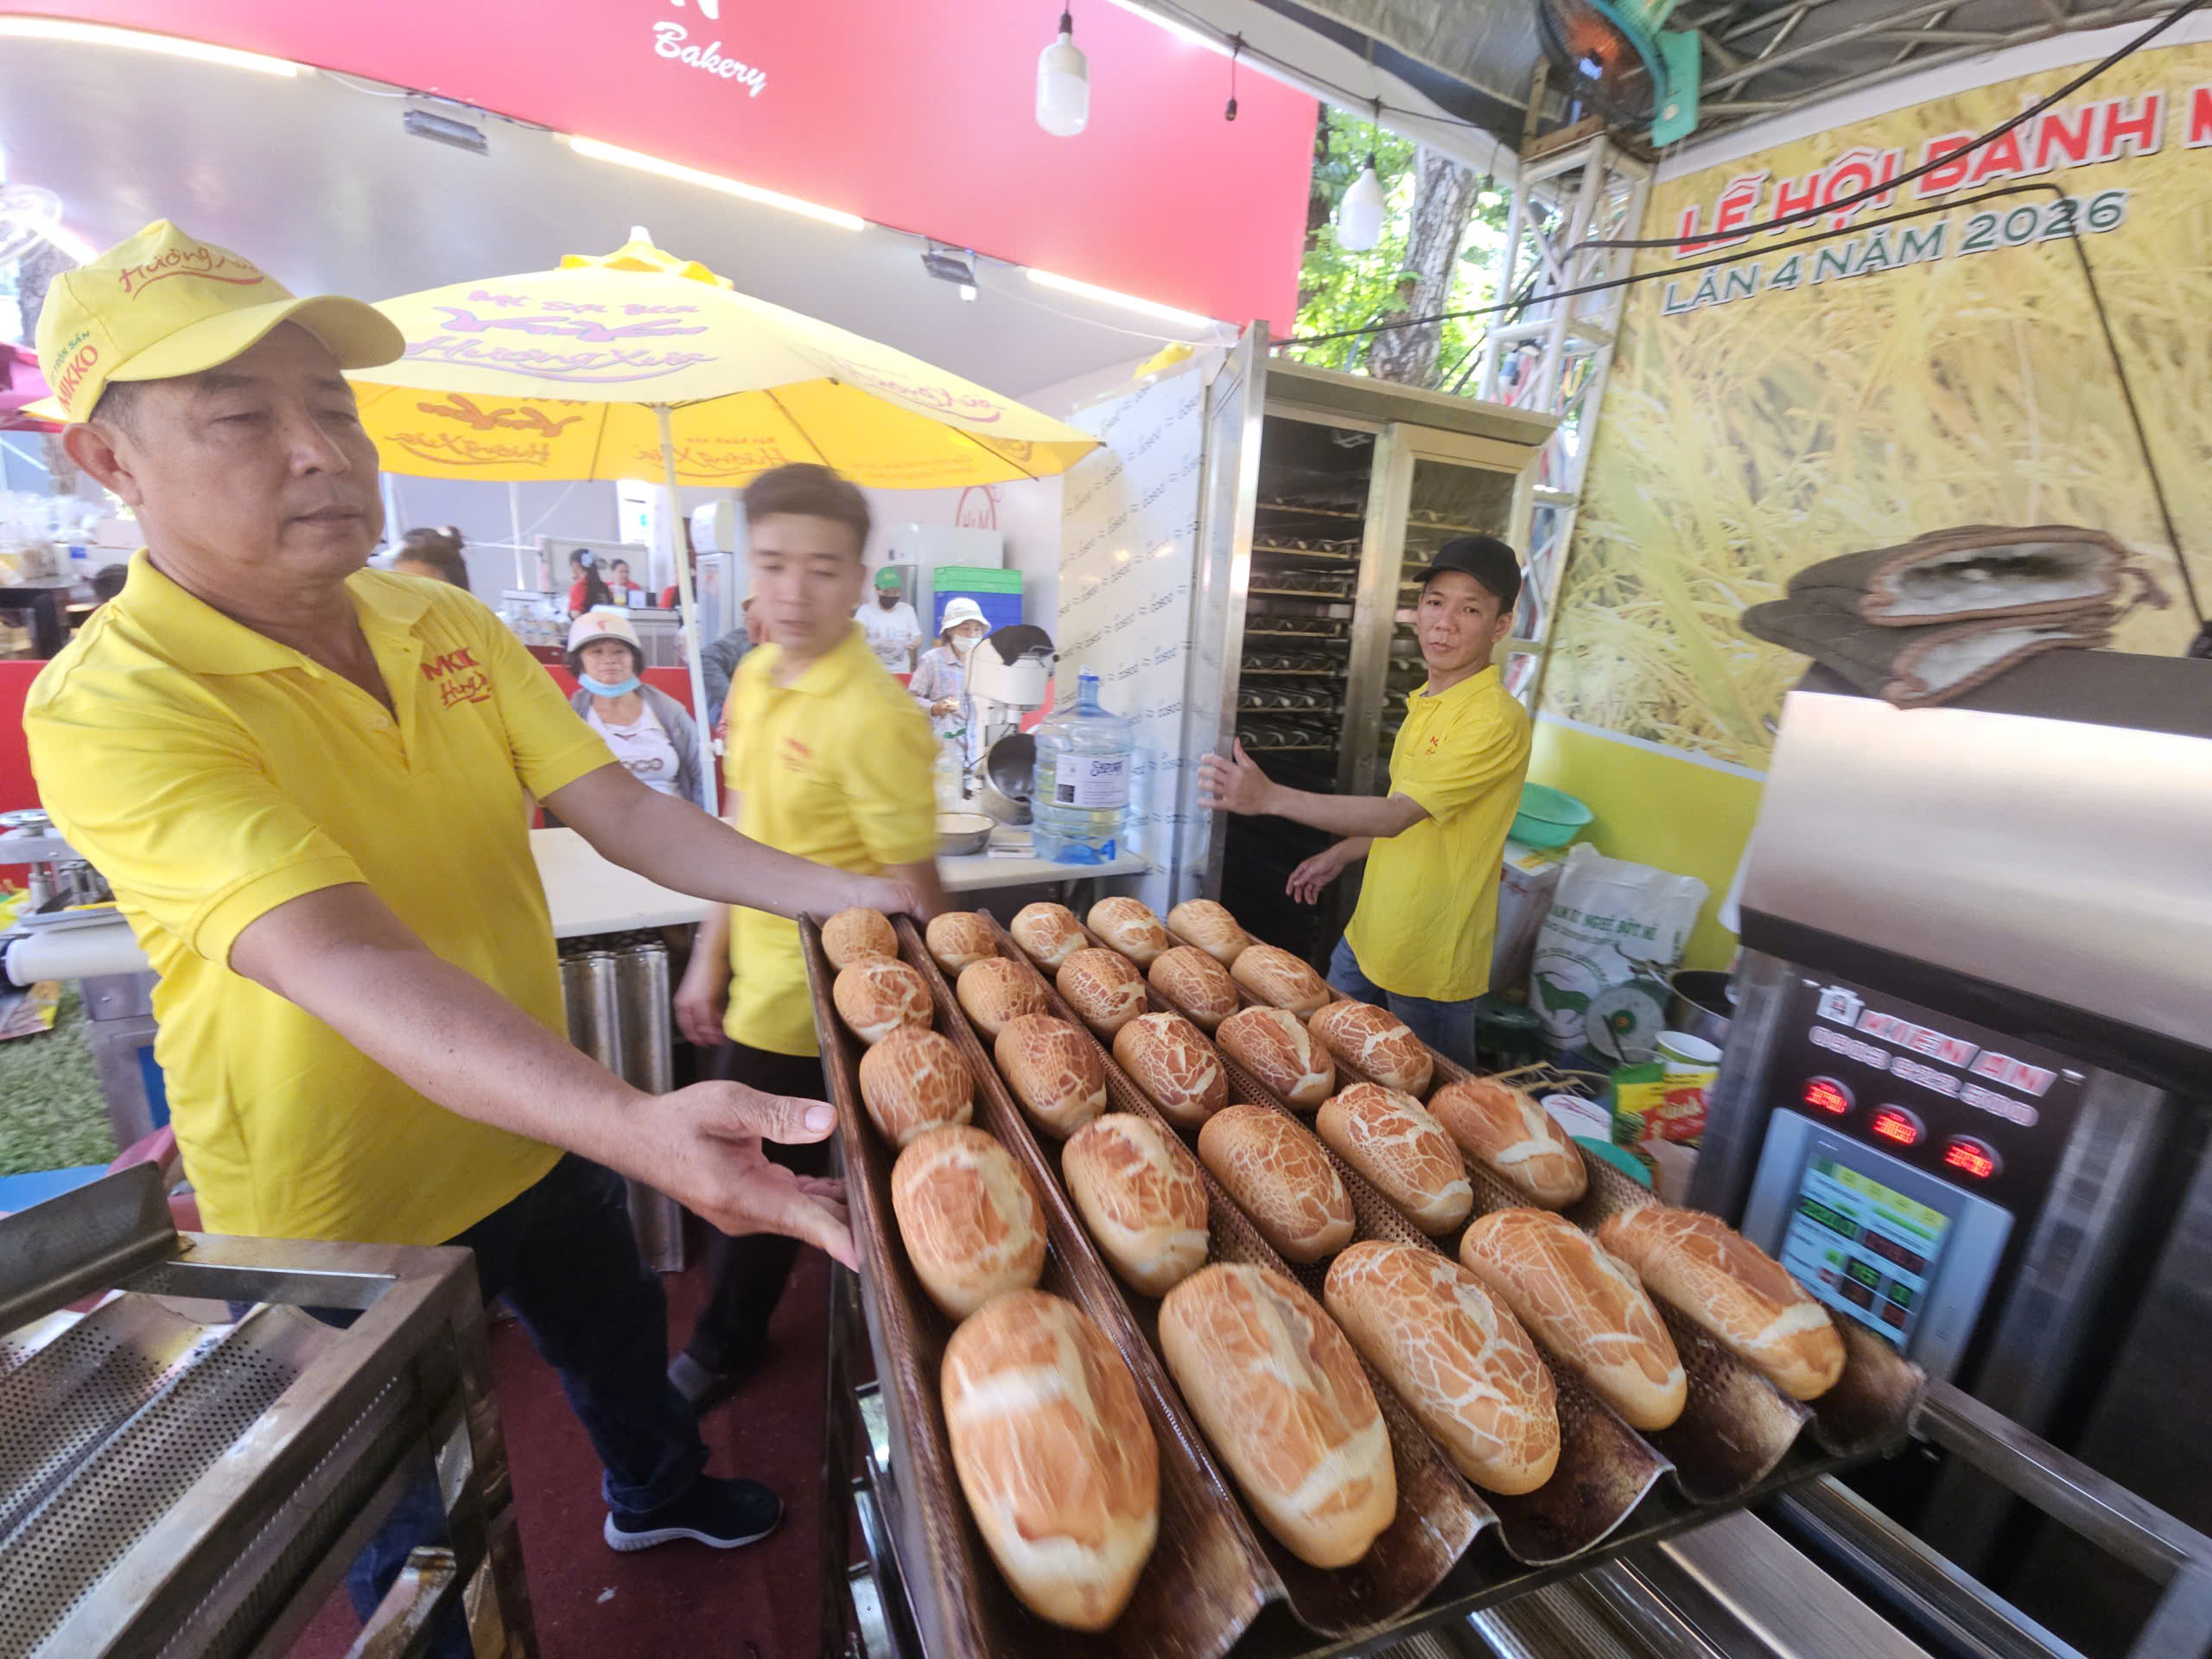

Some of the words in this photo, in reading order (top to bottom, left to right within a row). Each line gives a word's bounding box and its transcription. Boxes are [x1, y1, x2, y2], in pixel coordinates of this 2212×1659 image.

[652, 21, 766, 98] Bakery
[1676, 172, 1768, 258] LỄ
[1769, 147, 1904, 234] HỘI
[1769, 253, 1804, 289] 4
[1812, 222, 1948, 285] NĂM
[1957, 188, 2129, 257] 2026
[56, 345, 99, 415] MIKKO
